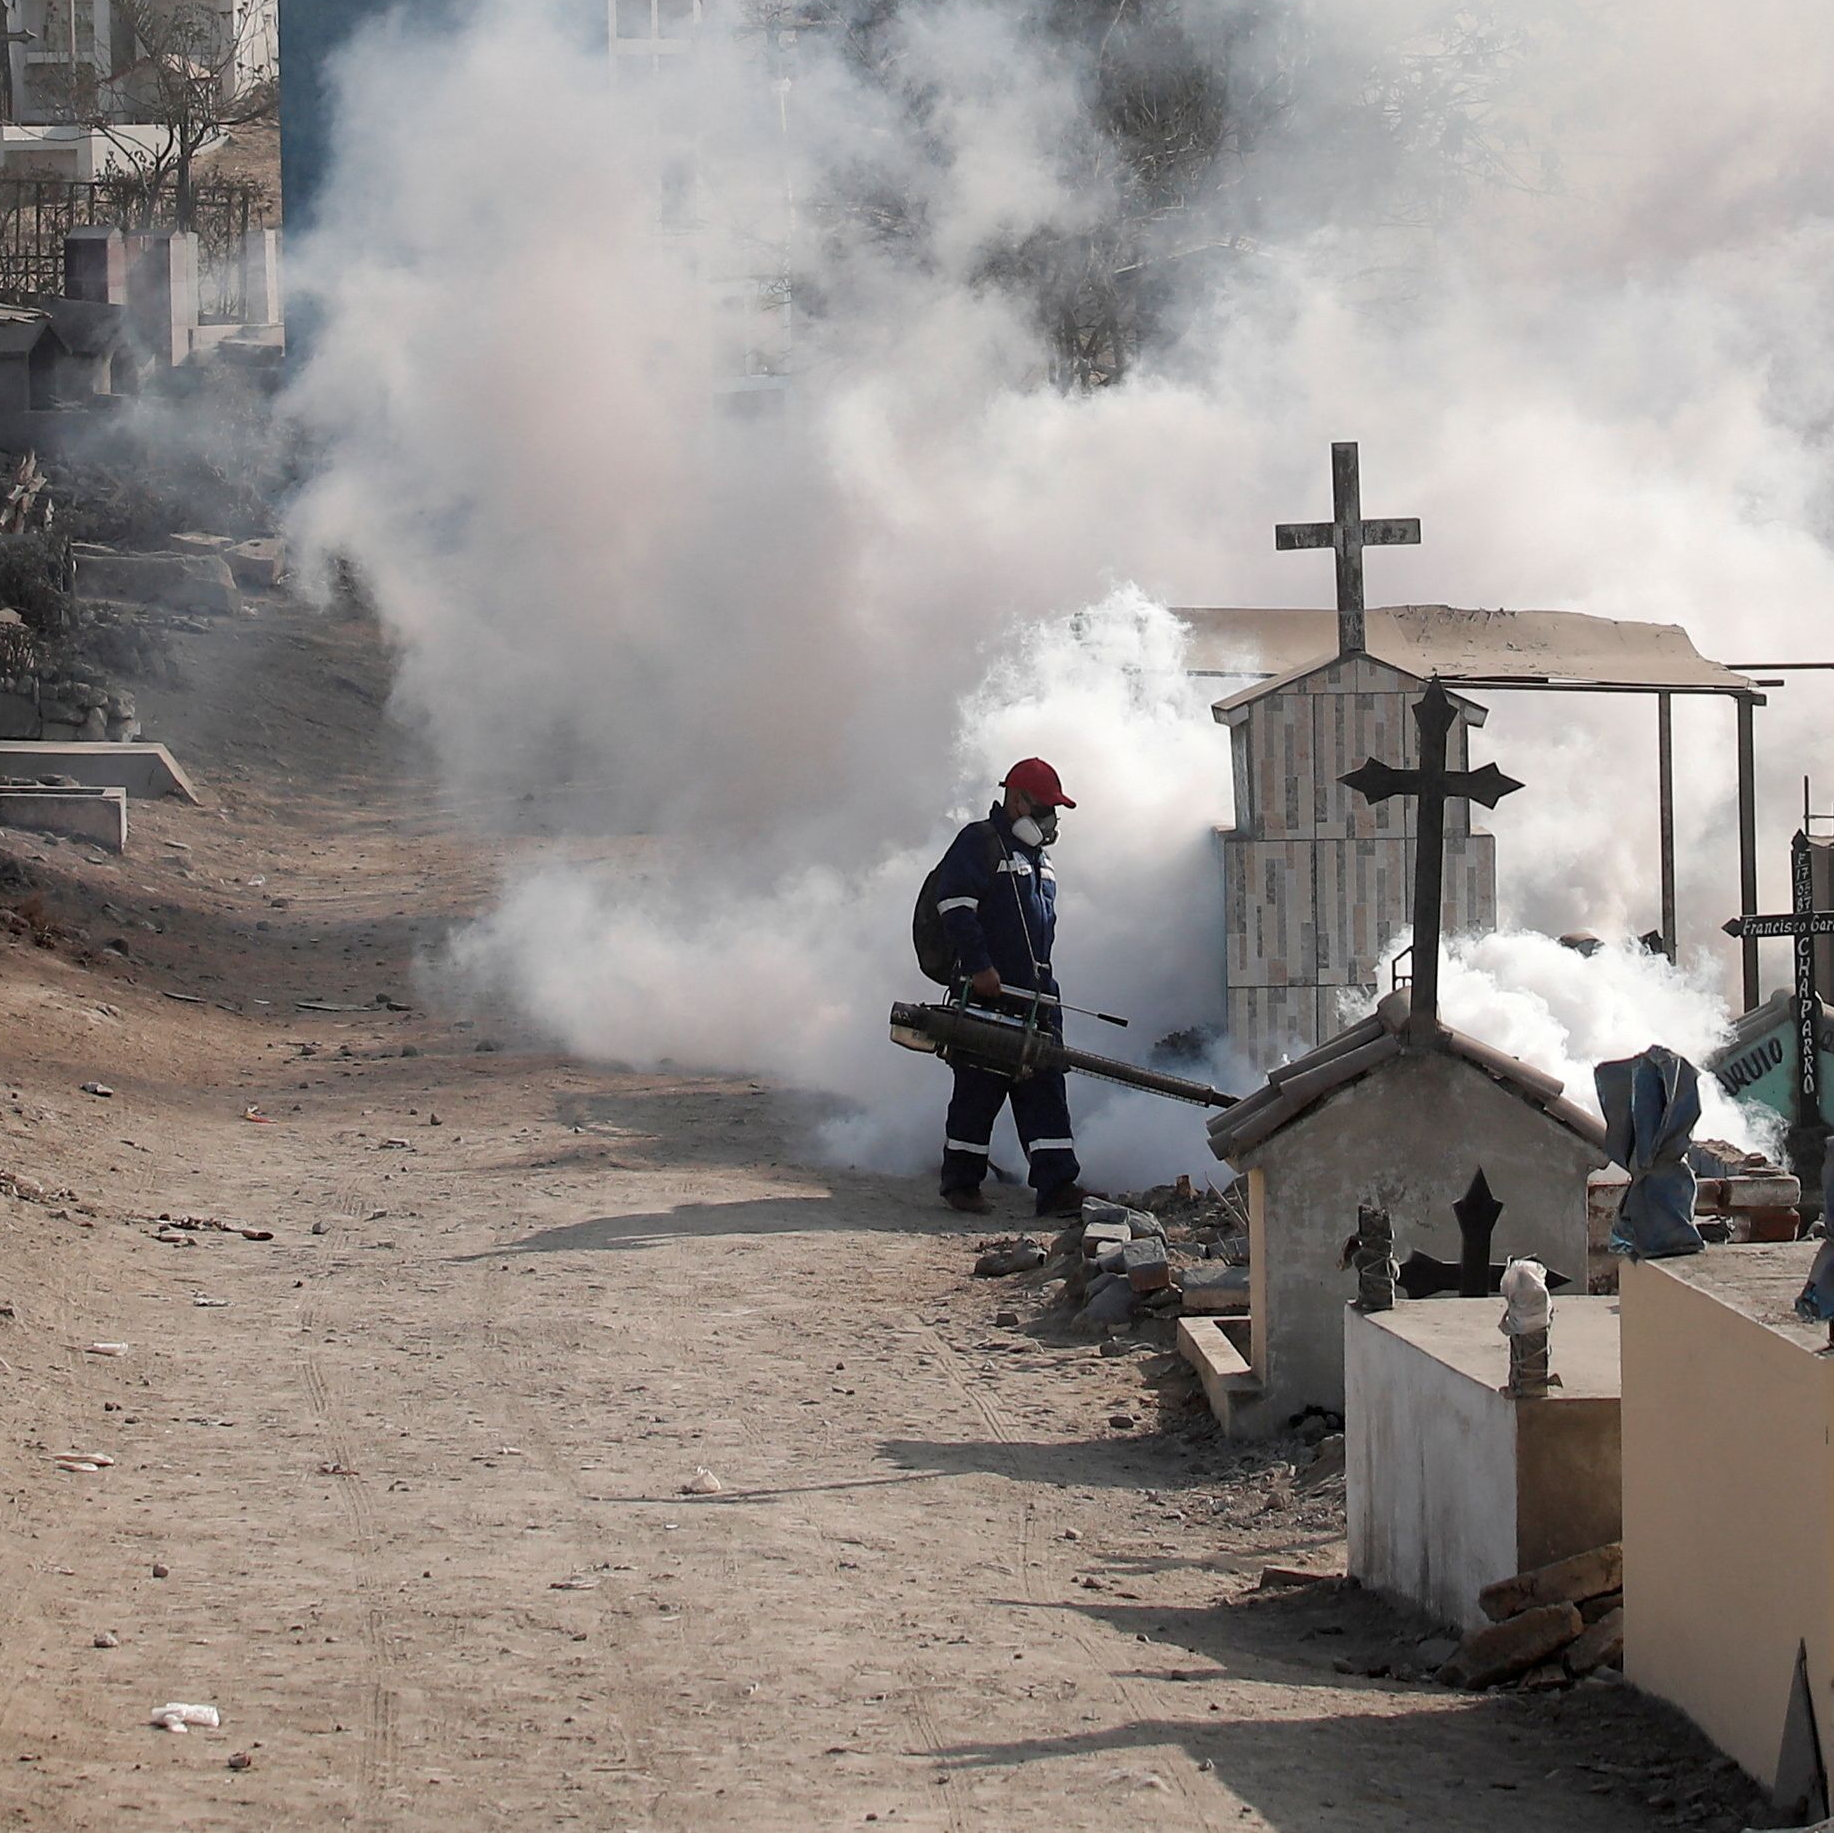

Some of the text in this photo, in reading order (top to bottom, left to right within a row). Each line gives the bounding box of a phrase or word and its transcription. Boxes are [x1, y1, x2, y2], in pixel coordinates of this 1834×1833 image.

[1796, 868, 1809, 880] 17
[1742, 918, 1806, 935] Francisco
[1797, 937, 1815, 1094] CHAPARRO
